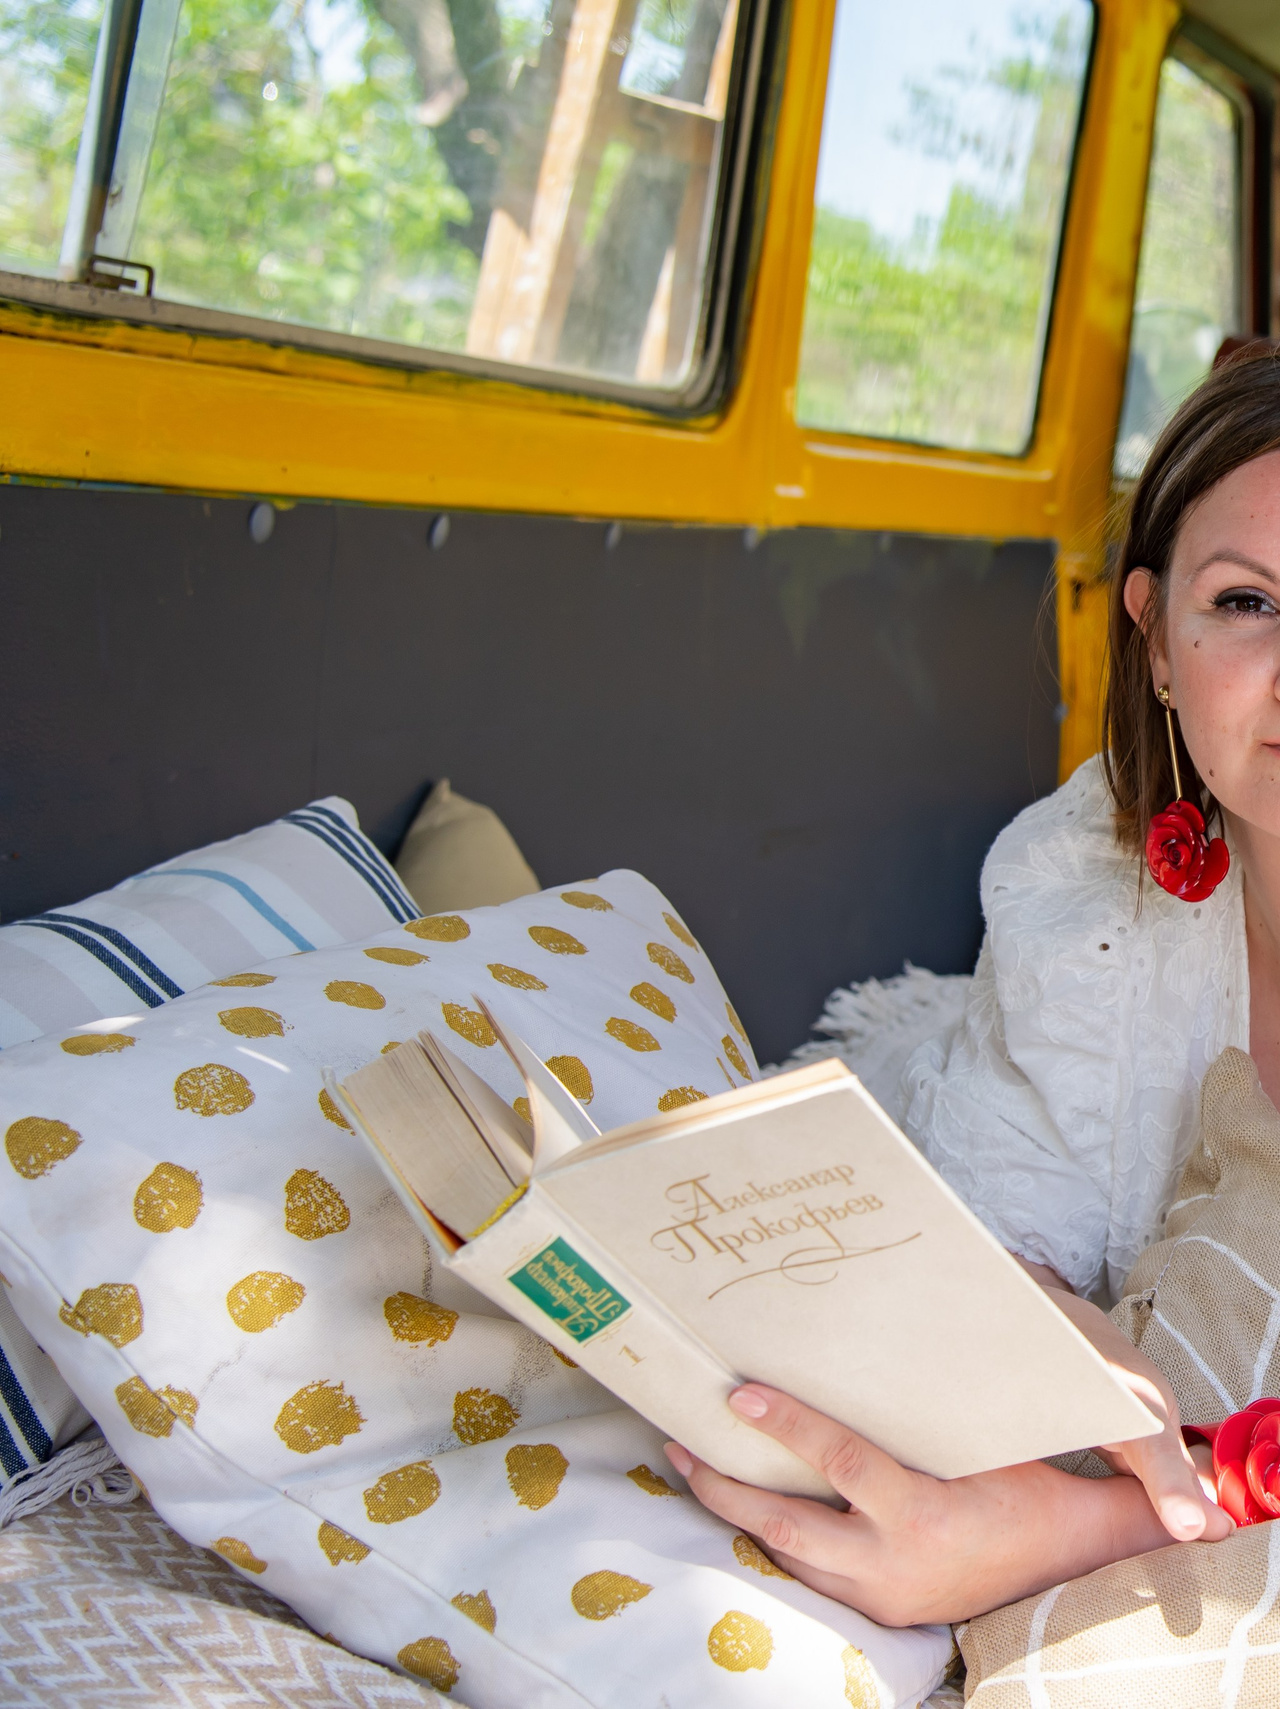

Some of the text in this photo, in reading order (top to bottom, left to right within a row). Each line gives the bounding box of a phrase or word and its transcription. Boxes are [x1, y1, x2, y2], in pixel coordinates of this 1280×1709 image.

[665, 1163, 856, 1222] Александр
[650, 1193, 885, 1264] Прокофьев
[525, 1262, 599, 1336] Александр
[541, 1249, 622, 1322] Прокофьев
[618, 1344, 648, 1367] 1
